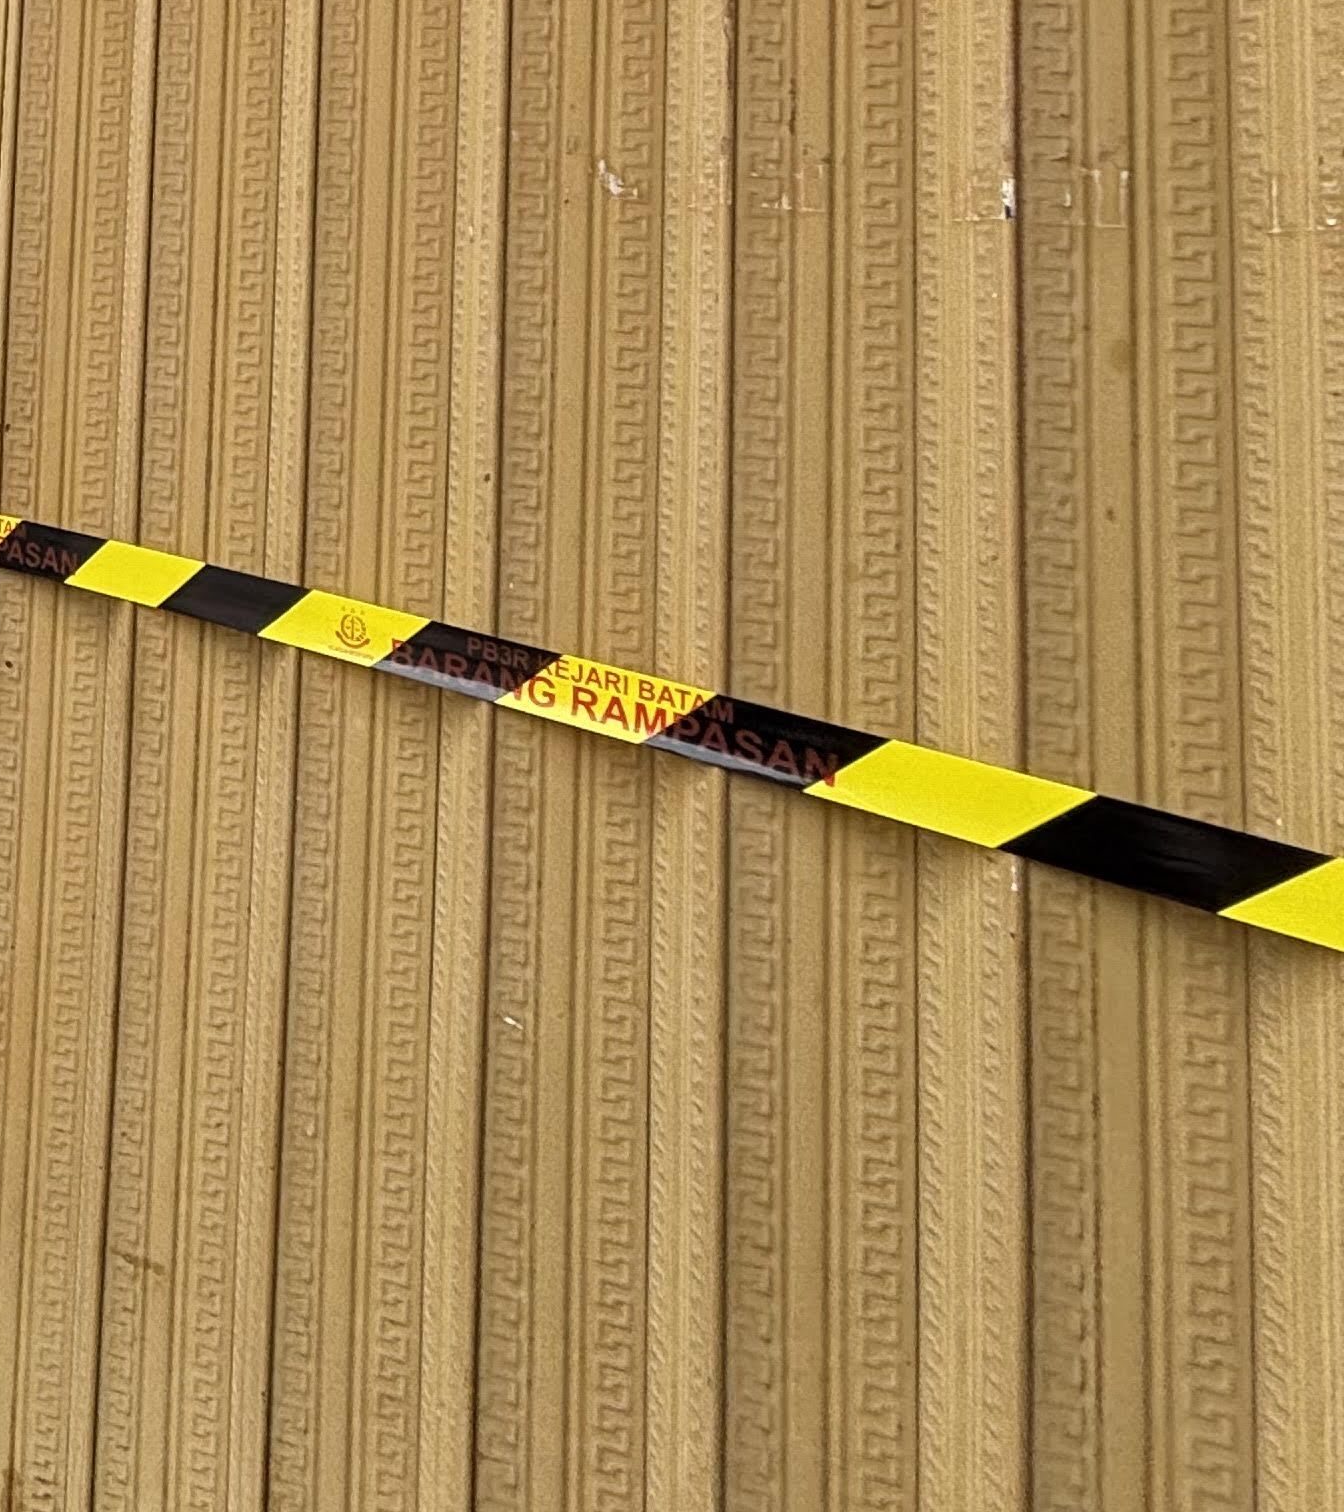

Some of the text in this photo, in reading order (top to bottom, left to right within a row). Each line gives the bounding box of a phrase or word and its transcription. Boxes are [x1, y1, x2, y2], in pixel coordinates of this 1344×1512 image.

[391, 638, 839, 788] BARANG RAMPASAN
[540, 657, 630, 695] KEJARI
[638, 679, 736, 725] BATAM
